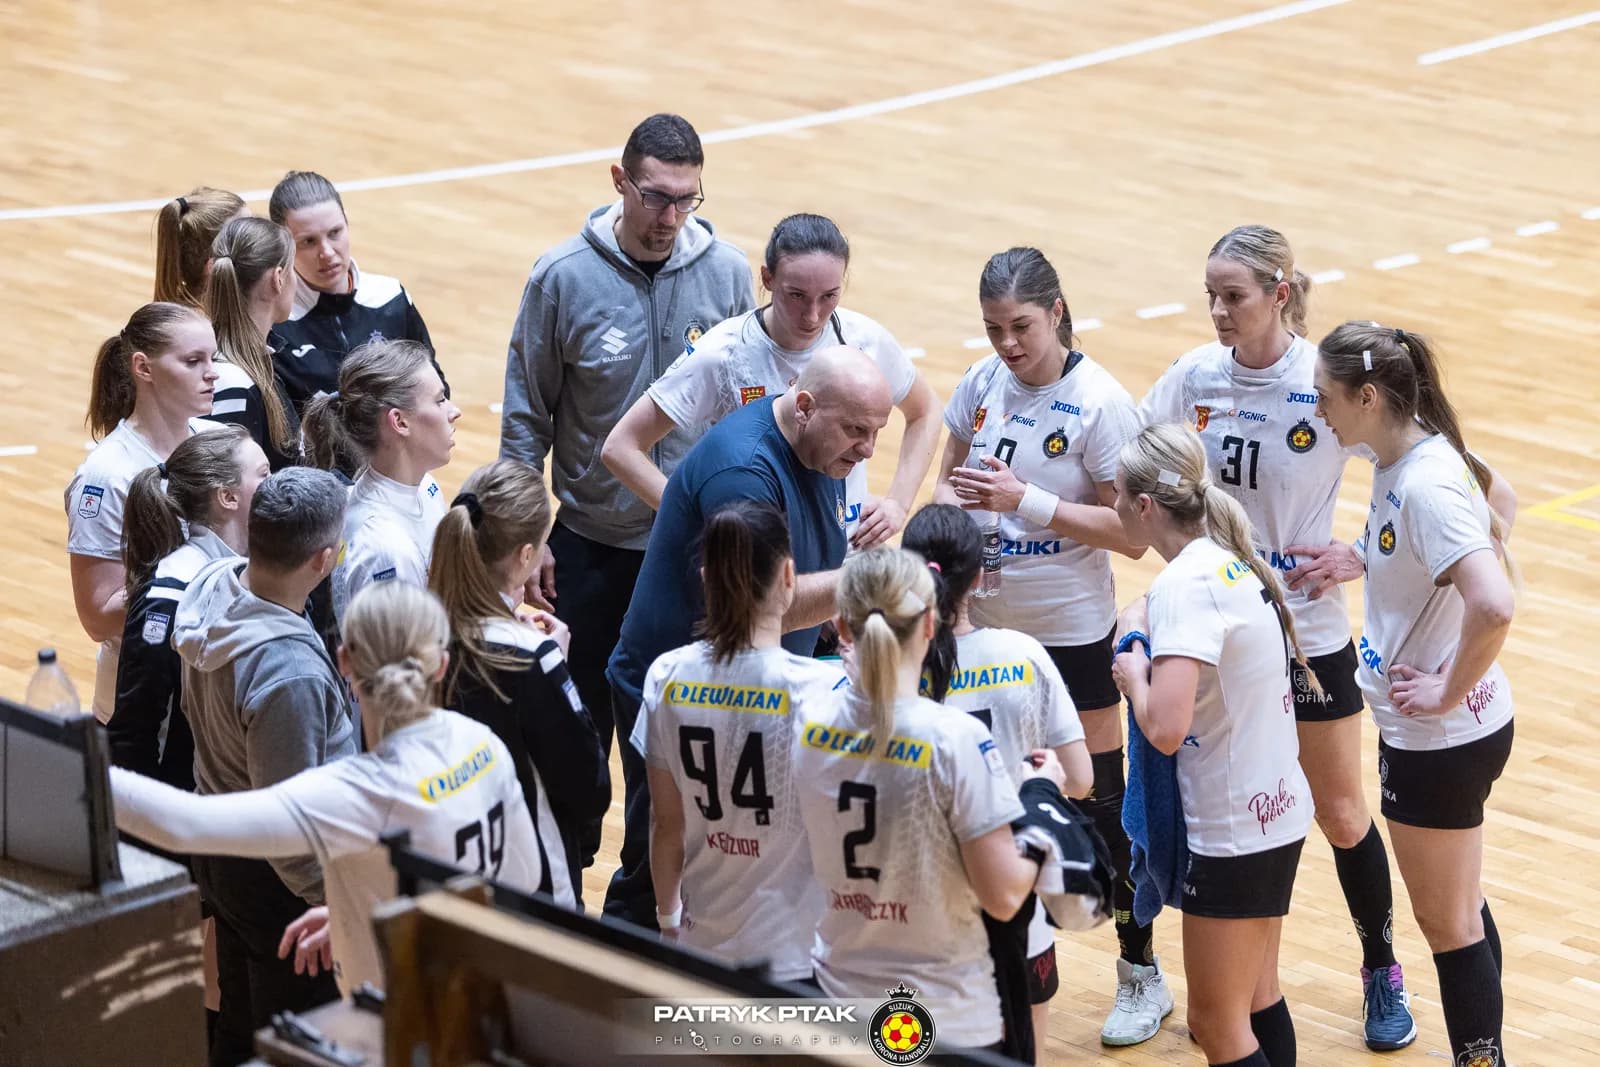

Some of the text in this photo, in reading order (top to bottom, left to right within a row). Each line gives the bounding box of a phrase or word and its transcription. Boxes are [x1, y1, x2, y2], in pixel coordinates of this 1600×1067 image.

[602, 354, 632, 363] SUZUKI
[1051, 400, 1080, 416] Joma
[1287, 391, 1318, 405] Jom
[1010, 414, 1037, 428] PGNiG
[1238, 410, 1267, 423] PGNiG
[1221, 434, 1260, 490] 31
[1001, 539, 1060, 555] ZUKI
[949, 664, 1024, 690] WIATAN
[690, 686, 783, 710] LEWIATAN
[679, 725, 775, 826] 94
[1248, 778, 1288, 823] Pink
[837, 780, 881, 883] 2
